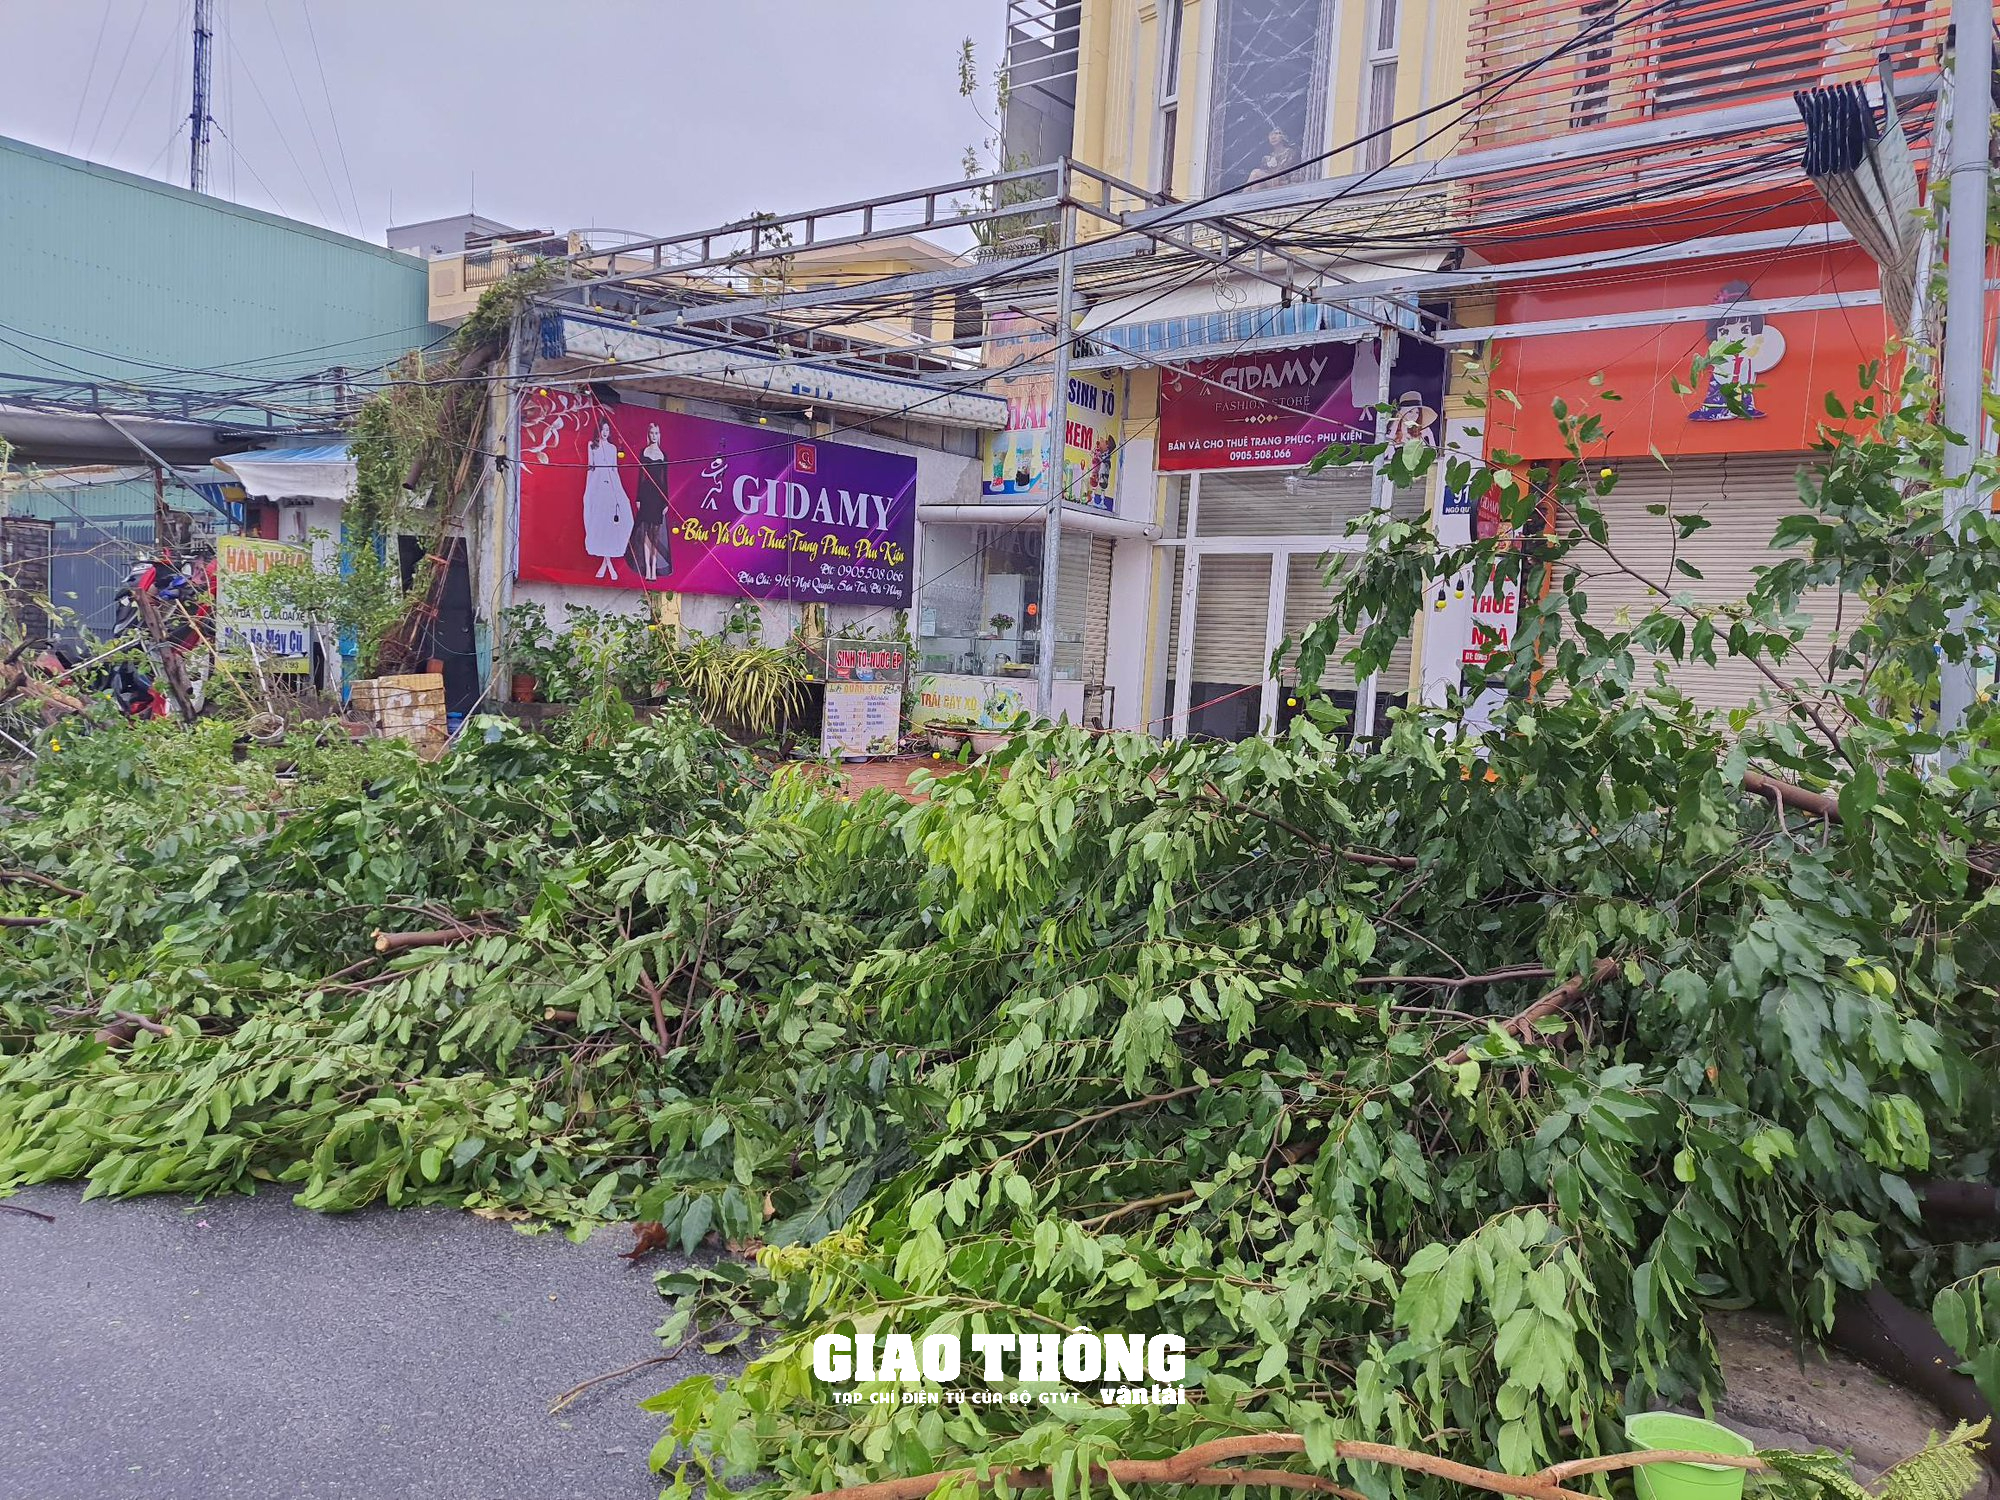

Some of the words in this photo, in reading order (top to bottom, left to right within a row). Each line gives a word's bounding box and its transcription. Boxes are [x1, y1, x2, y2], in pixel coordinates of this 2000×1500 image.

[1220, 356, 1328, 391] GIDAMY
[1068, 379, 1097, 411] SINH
[1102, 384, 1114, 416] TỐ
[1215, 400, 1265, 413] FASHION
[1271, 395, 1311, 408] STORE
[1065, 420, 1094, 451] KEM
[1168, 440, 1186, 451] BÁN
[1188, 439, 1201, 450] VÀ
[1203, 439, 1224, 449] CHO
[1227, 436, 1248, 447] THUÊ
[1251, 436, 1282, 446] TRANG
[1285, 433, 1315, 446] PHỤC,
[1340, 430, 1362, 443] KIỆN
[1230, 449, 1291, 461] 0905.508.066
[732, 474, 894, 531] GIDAMY
[1445, 505, 1459, 513] NGÔ
[682, 518, 709, 541] Bán
[712, 521, 731, 545] Và
[733, 524, 755, 547] Cho
[758, 526, 786, 549] Thuê
[788, 529, 819, 562] Trang
[855, 538, 878, 561] Phụ
[837, 564, 904, 582] 0905.508.066
[1472, 592, 1515, 614] THUÊ
[1472, 624, 1508, 646] NÀ
[837, 650, 856, 668] SINH
[857, 648, 868, 668] TỐ
[892, 649, 903, 670] ÉP
